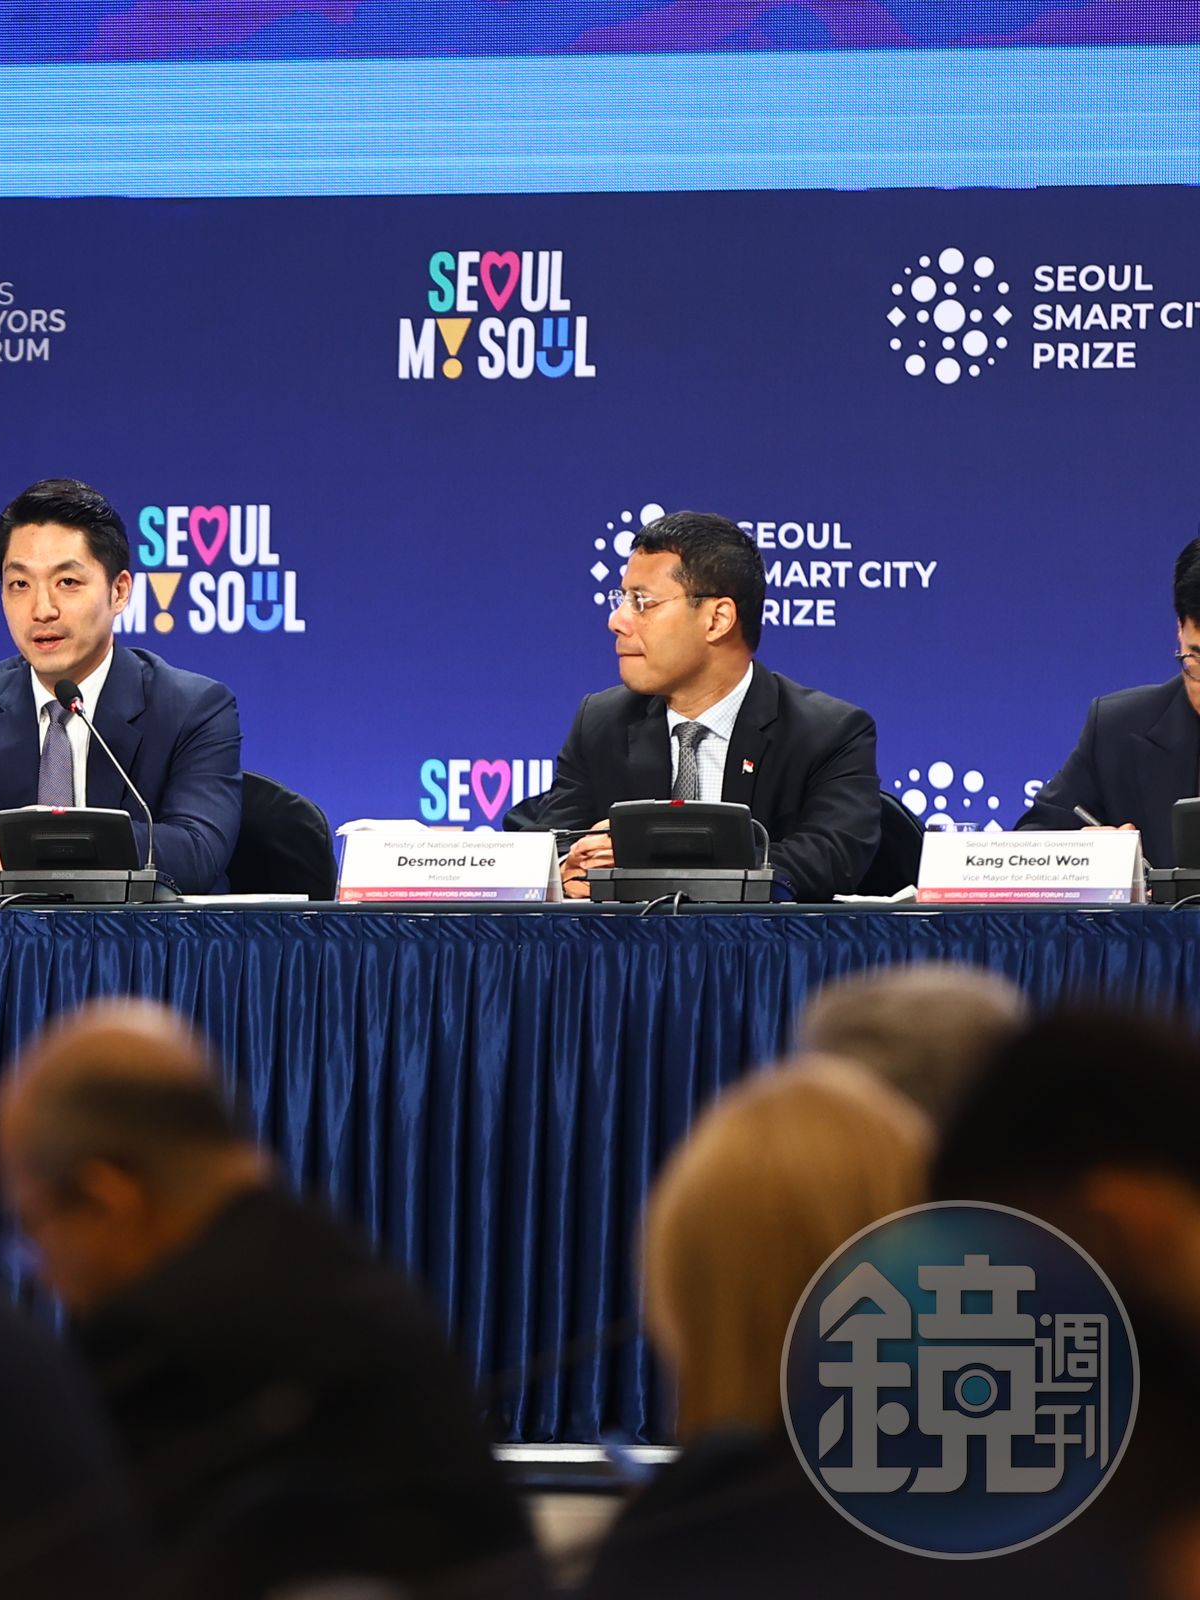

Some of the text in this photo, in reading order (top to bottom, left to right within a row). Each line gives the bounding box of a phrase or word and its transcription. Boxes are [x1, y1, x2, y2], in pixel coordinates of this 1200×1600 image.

[1033, 264, 1154, 292] SEOUL
[1032, 301, 1200, 331] SMART CI
[477, 315, 596, 379] SOUL
[1032, 341, 1137, 369] PRIZE
[765, 560, 938, 588] MART CITY
[188, 570, 306, 634] SOUL
[761, 598, 837, 627] RIZE
[384, 841, 515, 850] Ministry of National Development
[966, 840, 1094, 850] Seoul Metropolitan Government
[397, 855, 496, 867] Desmond Lee
[965, 855, 1090, 869] Kang Cheol Won
[962, 873, 1090, 883] Vice Mayor for Political Affairs
